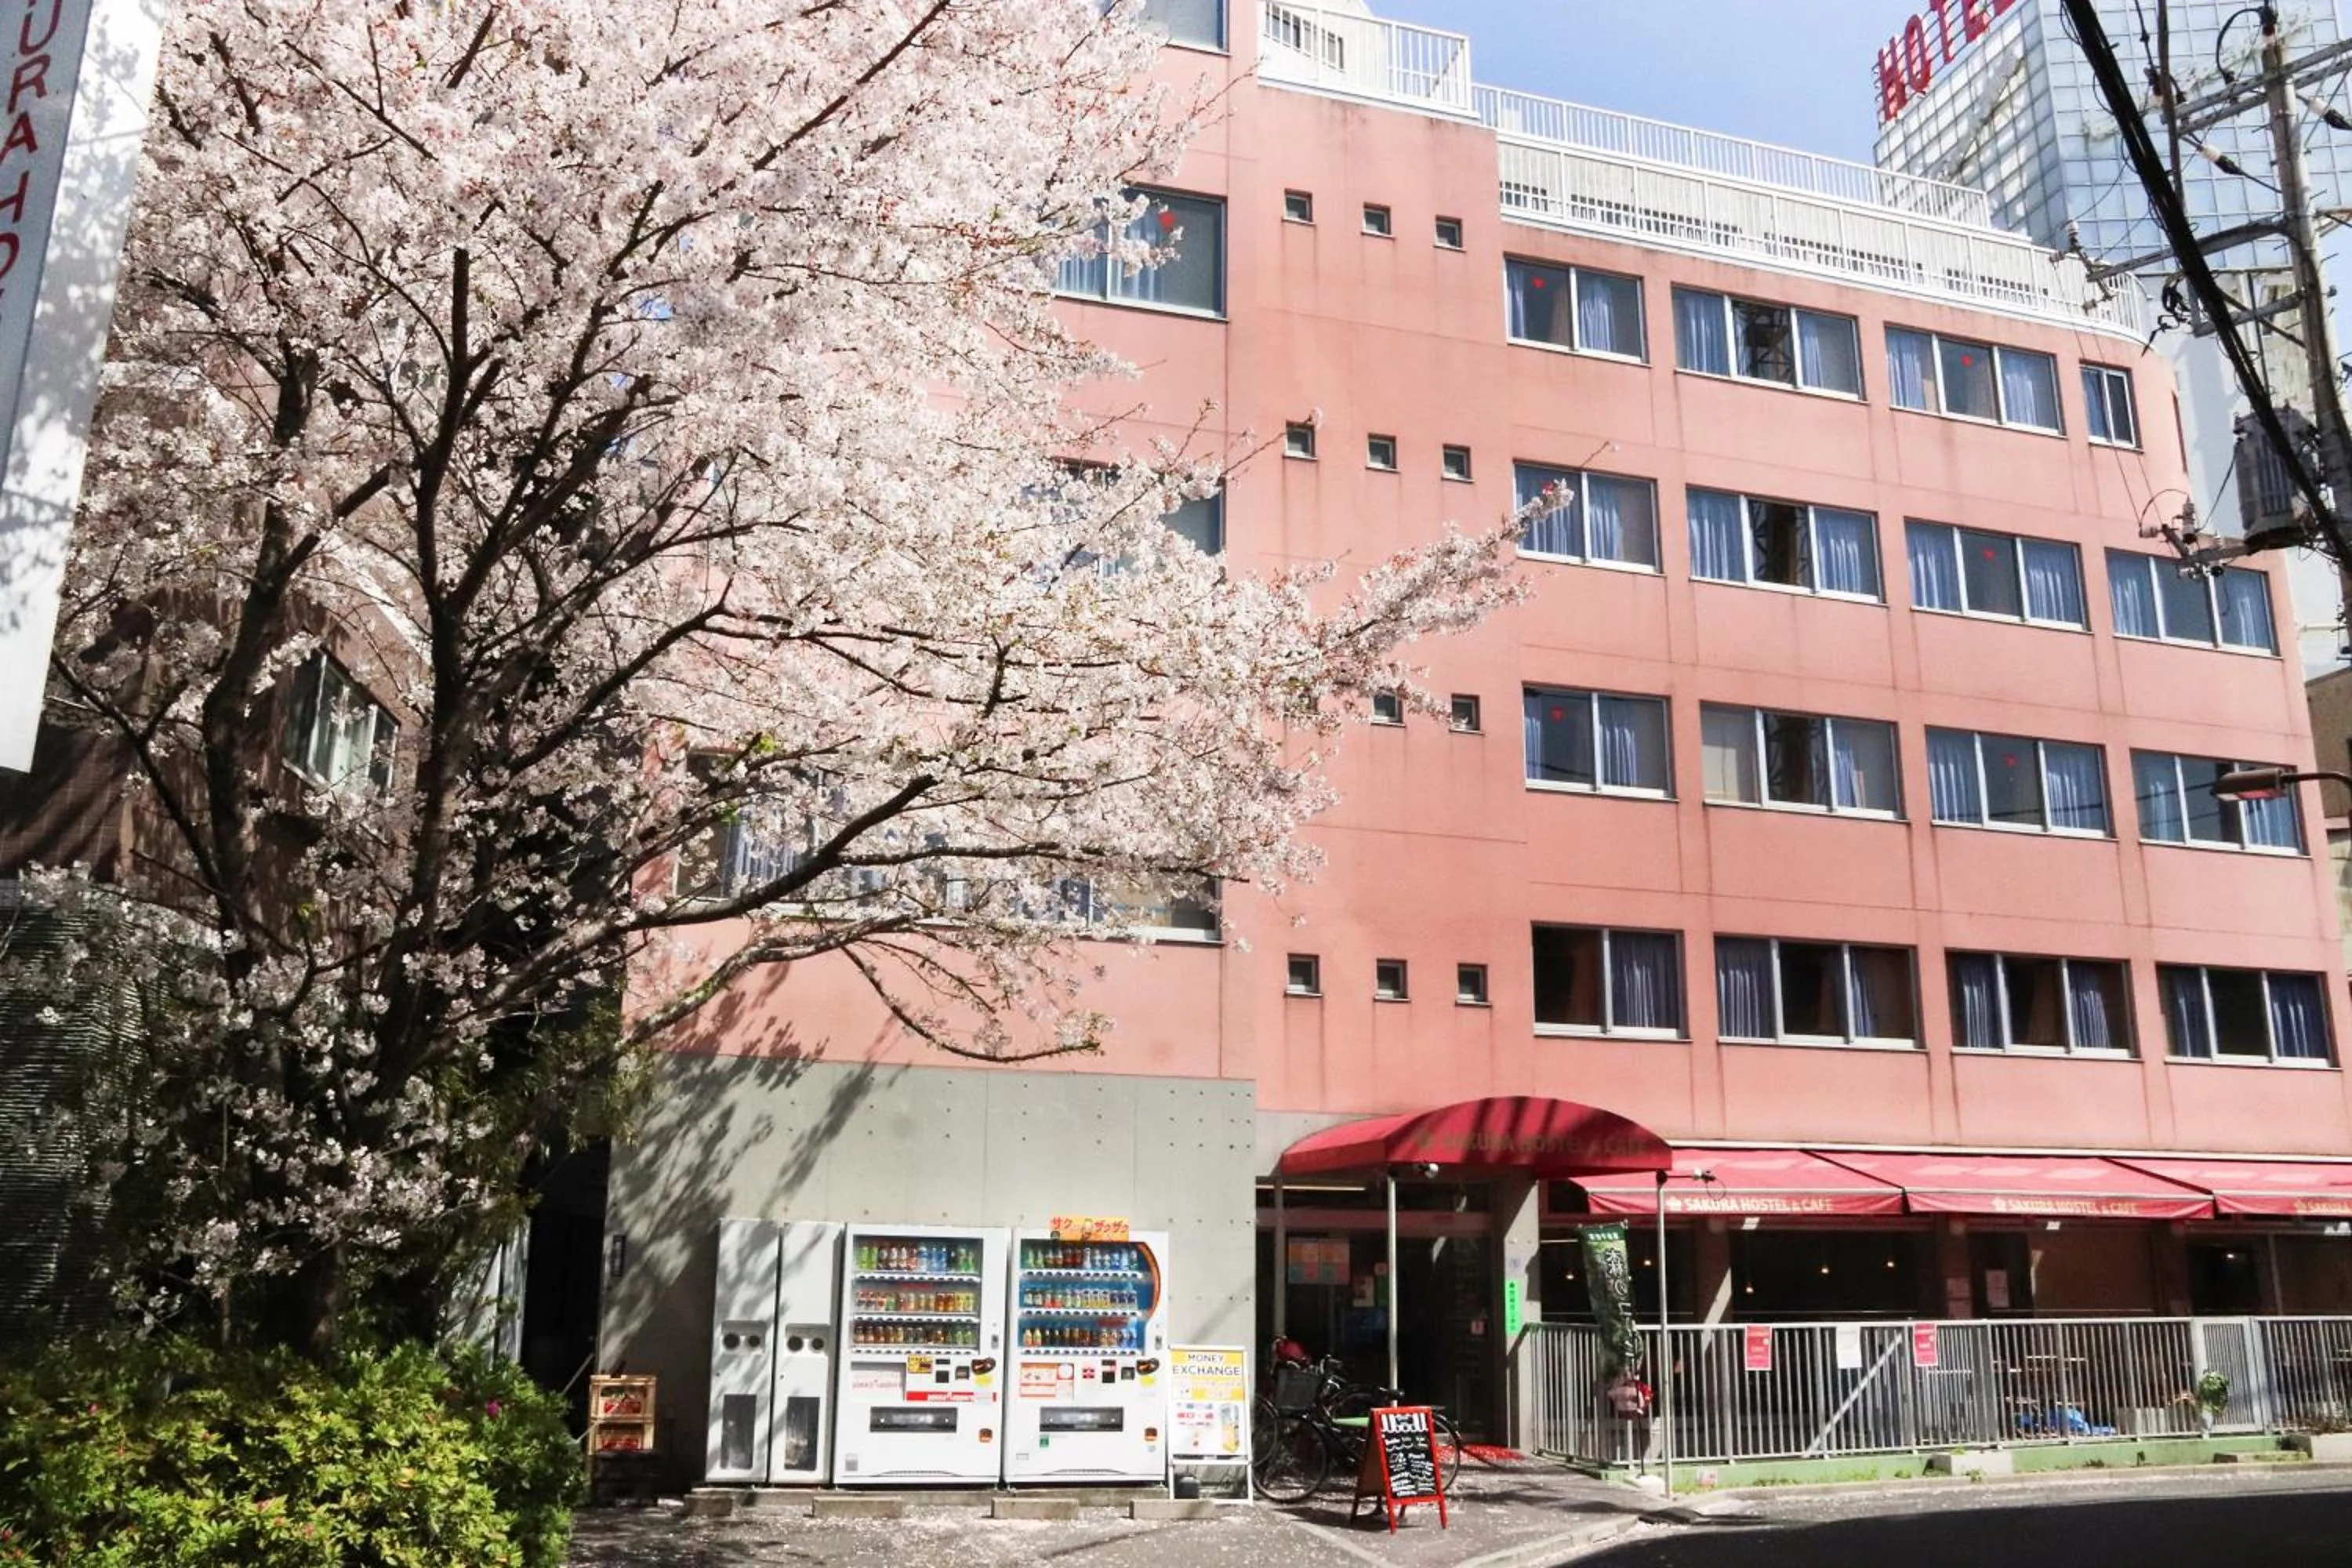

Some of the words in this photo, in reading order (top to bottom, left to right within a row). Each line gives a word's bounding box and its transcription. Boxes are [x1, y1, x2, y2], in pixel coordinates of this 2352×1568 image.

[1878, 0, 2016, 121] HOTE
[1686, 1198, 1739, 1211] SAKURA
[1741, 1198, 1790, 1211] HOSTEL
[1802, 1199, 1835, 1211] CAFE
[1187, 1353, 1225, 1363] MONEY
[1172, 1364, 1243, 1376] EXCHANGE
